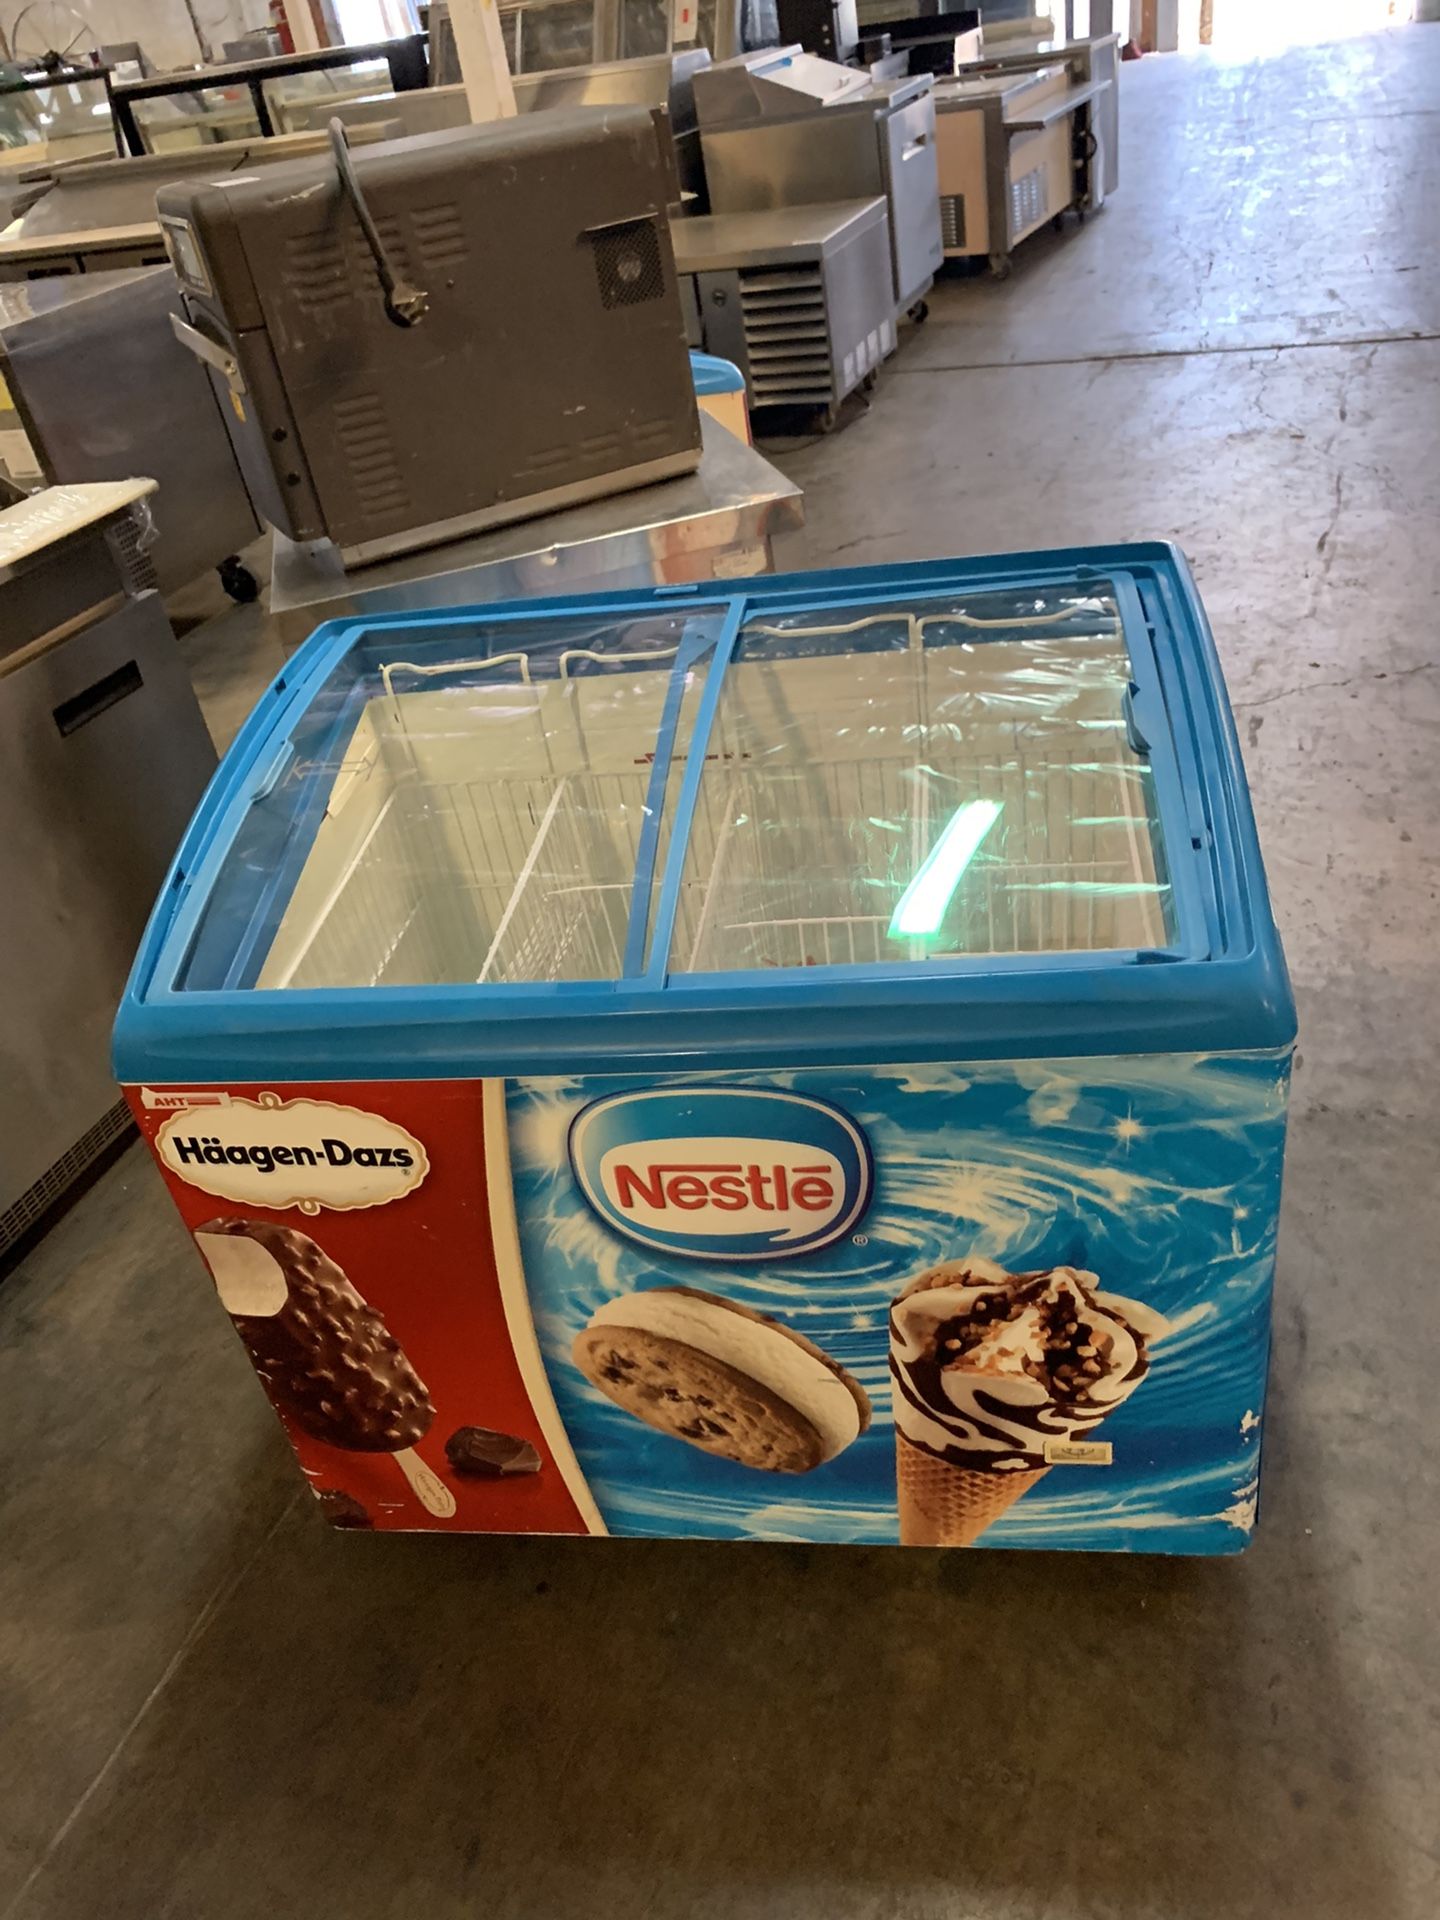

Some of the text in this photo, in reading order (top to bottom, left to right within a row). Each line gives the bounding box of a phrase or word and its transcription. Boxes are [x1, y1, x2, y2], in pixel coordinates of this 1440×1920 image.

[154, 1097, 185, 1107] AHT
[171, 1136, 415, 1173] Häagen-Dazs
[613, 1164, 835, 1211] Nestlé
